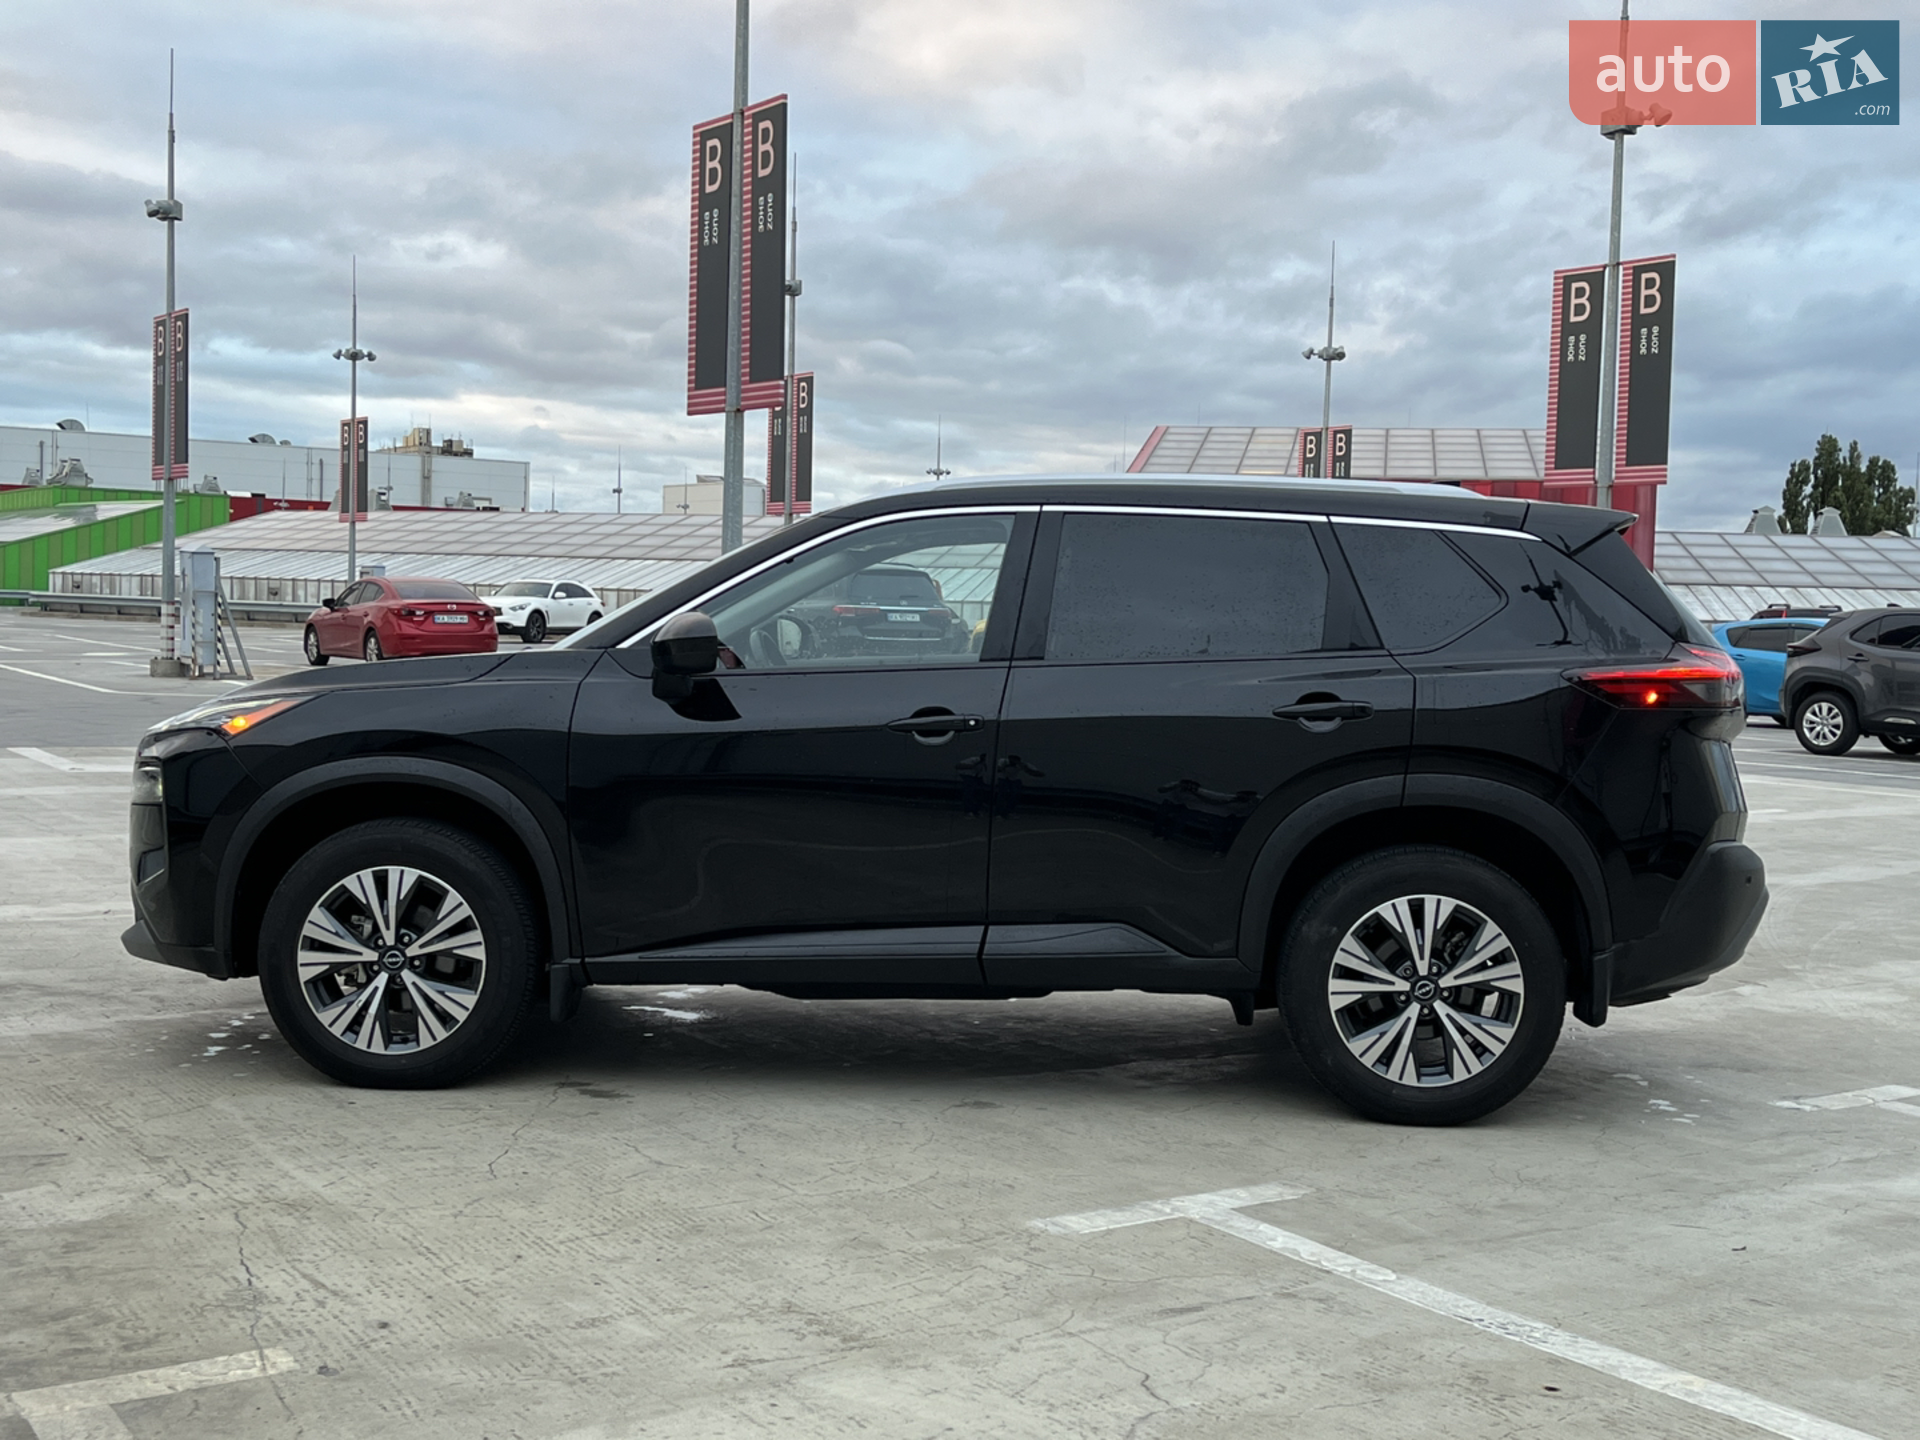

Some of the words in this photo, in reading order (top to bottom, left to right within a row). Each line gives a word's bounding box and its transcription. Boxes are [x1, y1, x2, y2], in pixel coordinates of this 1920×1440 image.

[758, 119, 775, 178] B
[705, 138, 722, 194] B
[766, 192, 774, 231] zone
[1568, 281, 1592, 323] B
[1639, 271, 1662, 315] B
[157, 326, 165, 356] B
[176, 321, 183, 352] B
[1578, 333, 1587, 361] zone
[1651, 325, 1660, 354] zone
[799, 382, 808, 408] B
[343, 426, 349, 445] B
[359, 424, 365, 443] B
[1306, 435, 1317, 458] B
[1335, 433, 1346, 456] B
